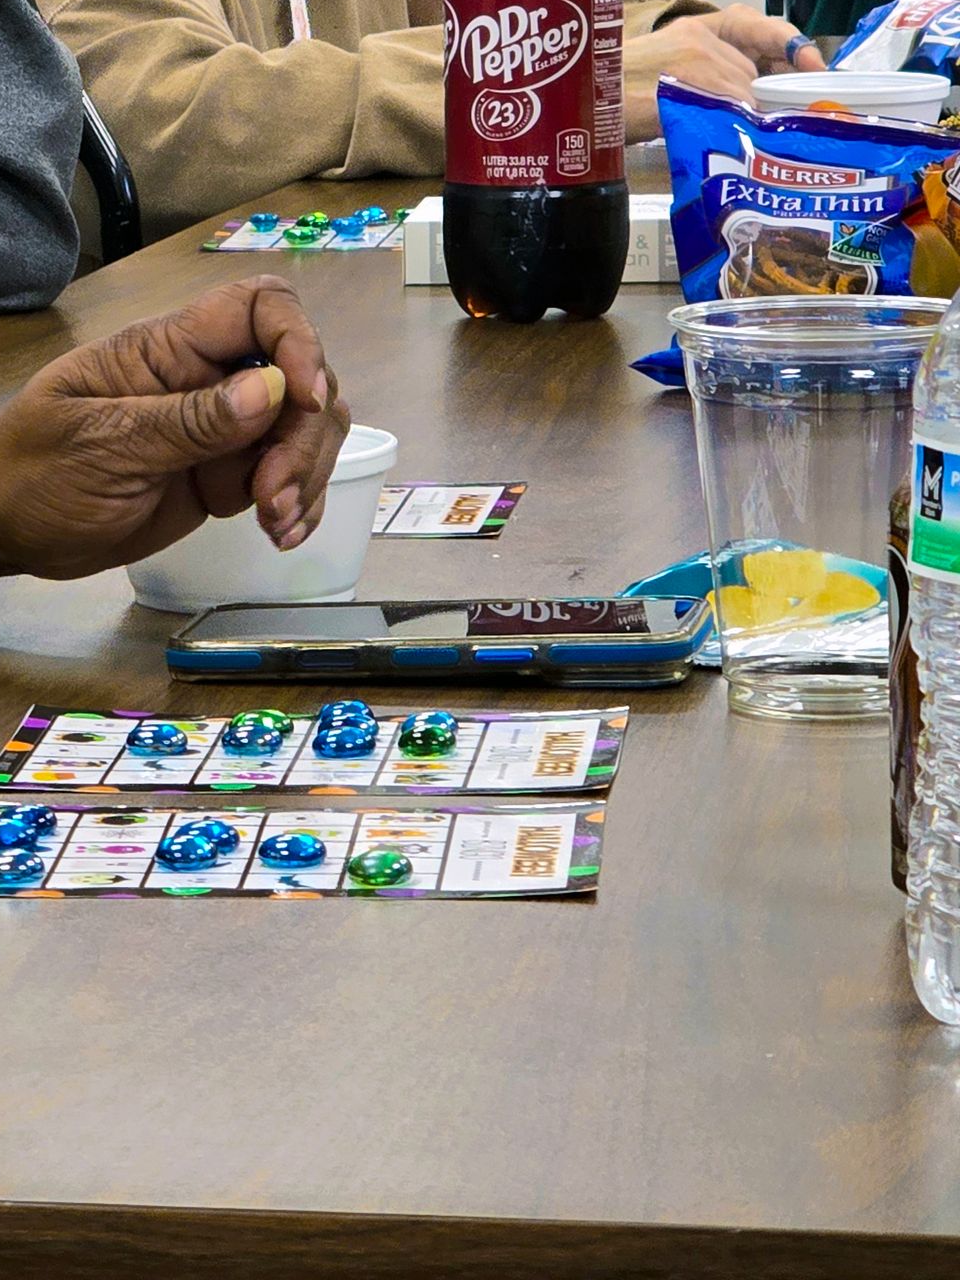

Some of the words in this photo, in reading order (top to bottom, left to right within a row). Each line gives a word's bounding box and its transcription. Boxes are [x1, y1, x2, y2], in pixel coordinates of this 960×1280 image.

[497, 5, 548, 47] Dr
[460, 15, 579, 84] Pepper
[488, 100, 516, 127] 23
[564, 134, 584, 149] 150
[760, 162, 847, 185] HERR'S
[720, 178, 802, 212] Extra
[808, 195, 884, 213] Thin
